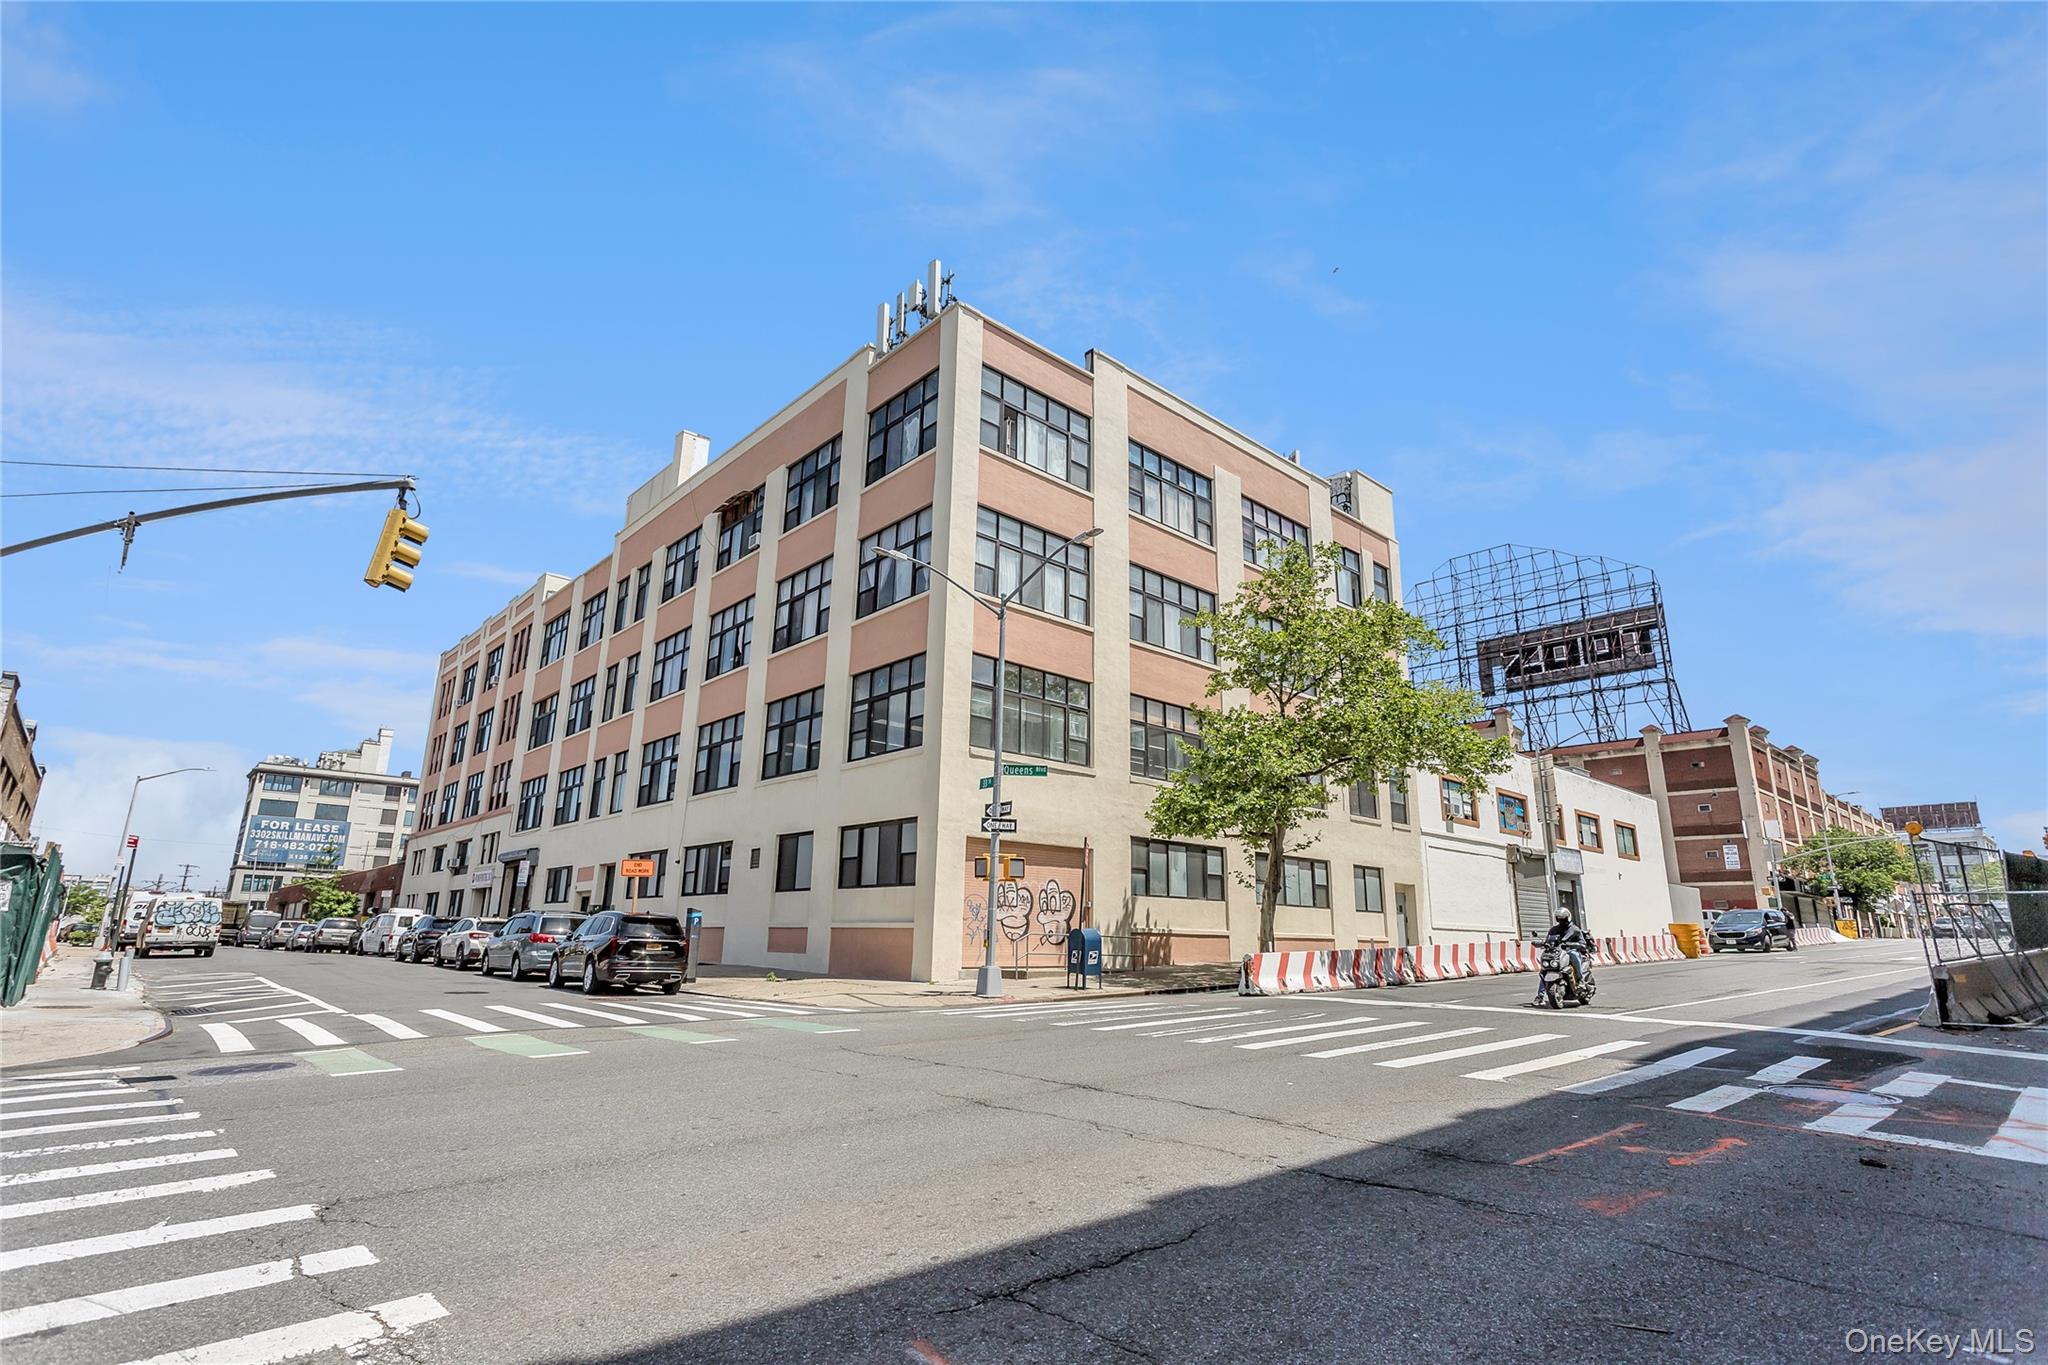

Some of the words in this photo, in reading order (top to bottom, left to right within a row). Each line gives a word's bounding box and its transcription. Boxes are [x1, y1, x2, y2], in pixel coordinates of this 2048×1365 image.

[1004, 765, 1034, 775] Queens
[260, 820, 290, 830] FOR
[295, 823, 340, 833] LEASE
[250, 829, 346, 844] 3302SKILLMANAVE.COM
[693, 917, 699, 926] P
